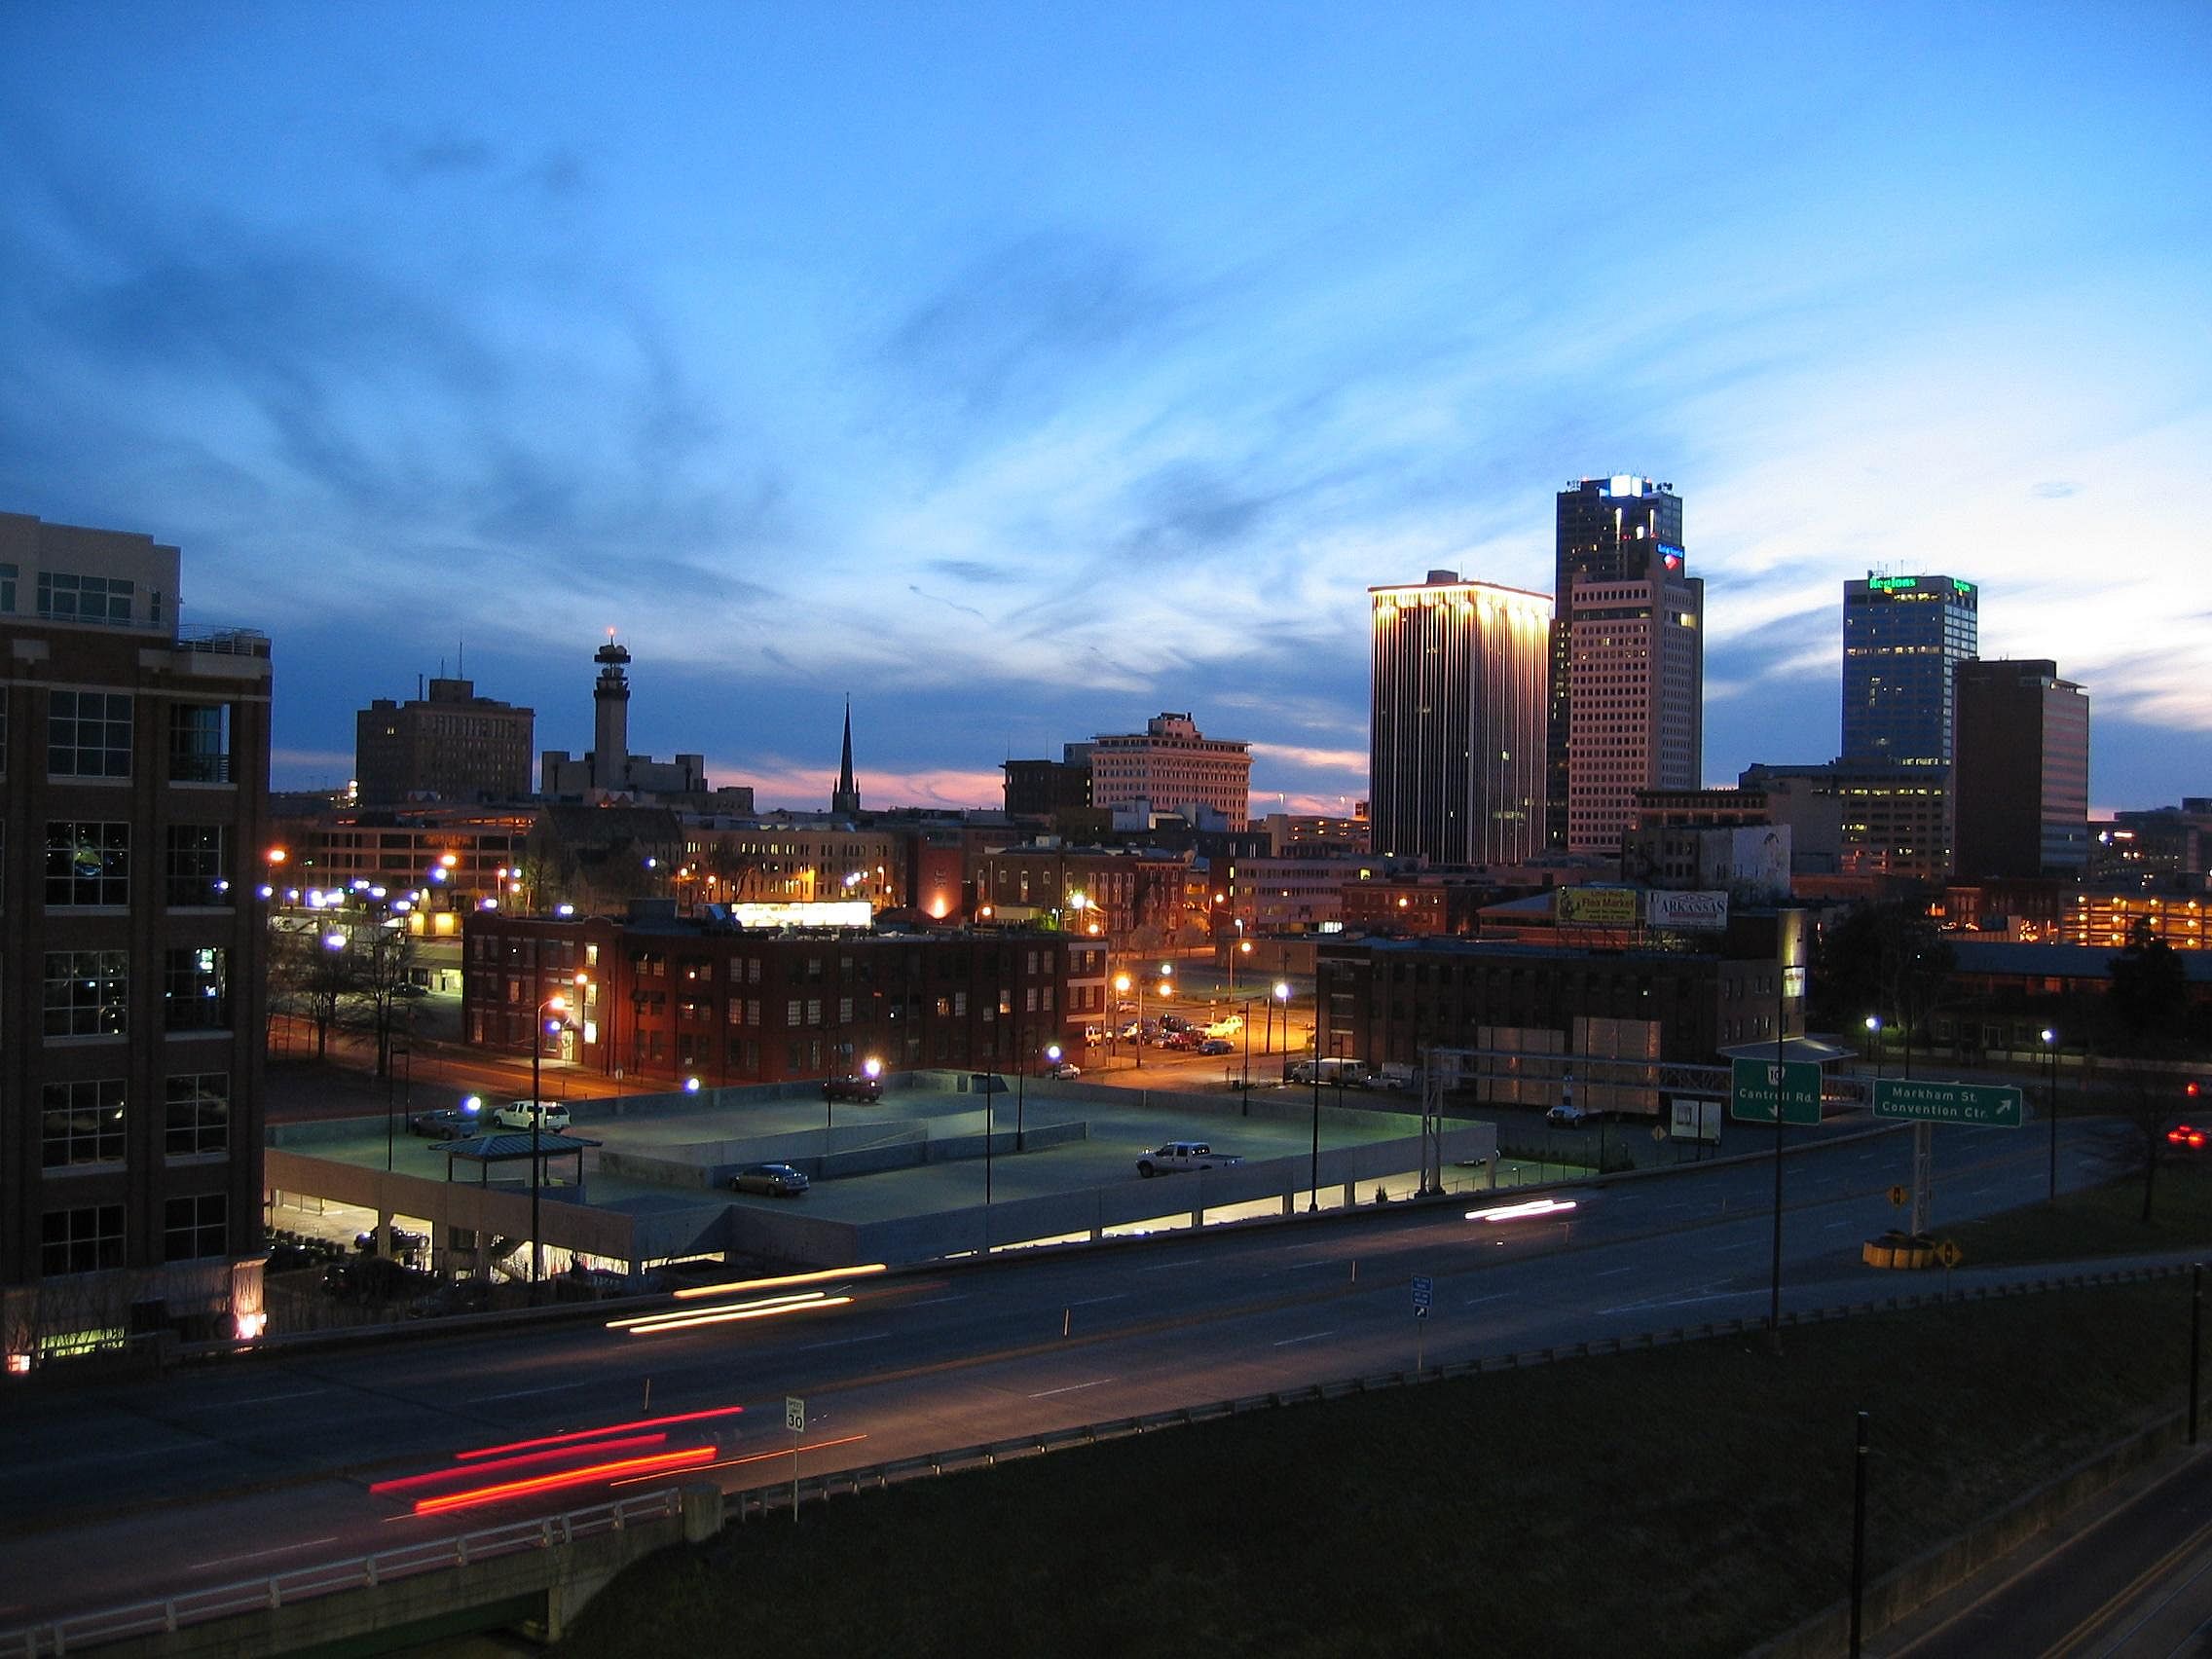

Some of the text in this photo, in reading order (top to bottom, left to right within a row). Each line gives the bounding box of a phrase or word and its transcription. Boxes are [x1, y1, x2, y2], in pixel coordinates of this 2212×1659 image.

[1660, 900, 1725, 912] ARKANSAS
[1892, 1087, 1954, 1101] Markham
[1882, 1101, 1957, 1117] Convention
[789, 1414, 803, 1429] 30
